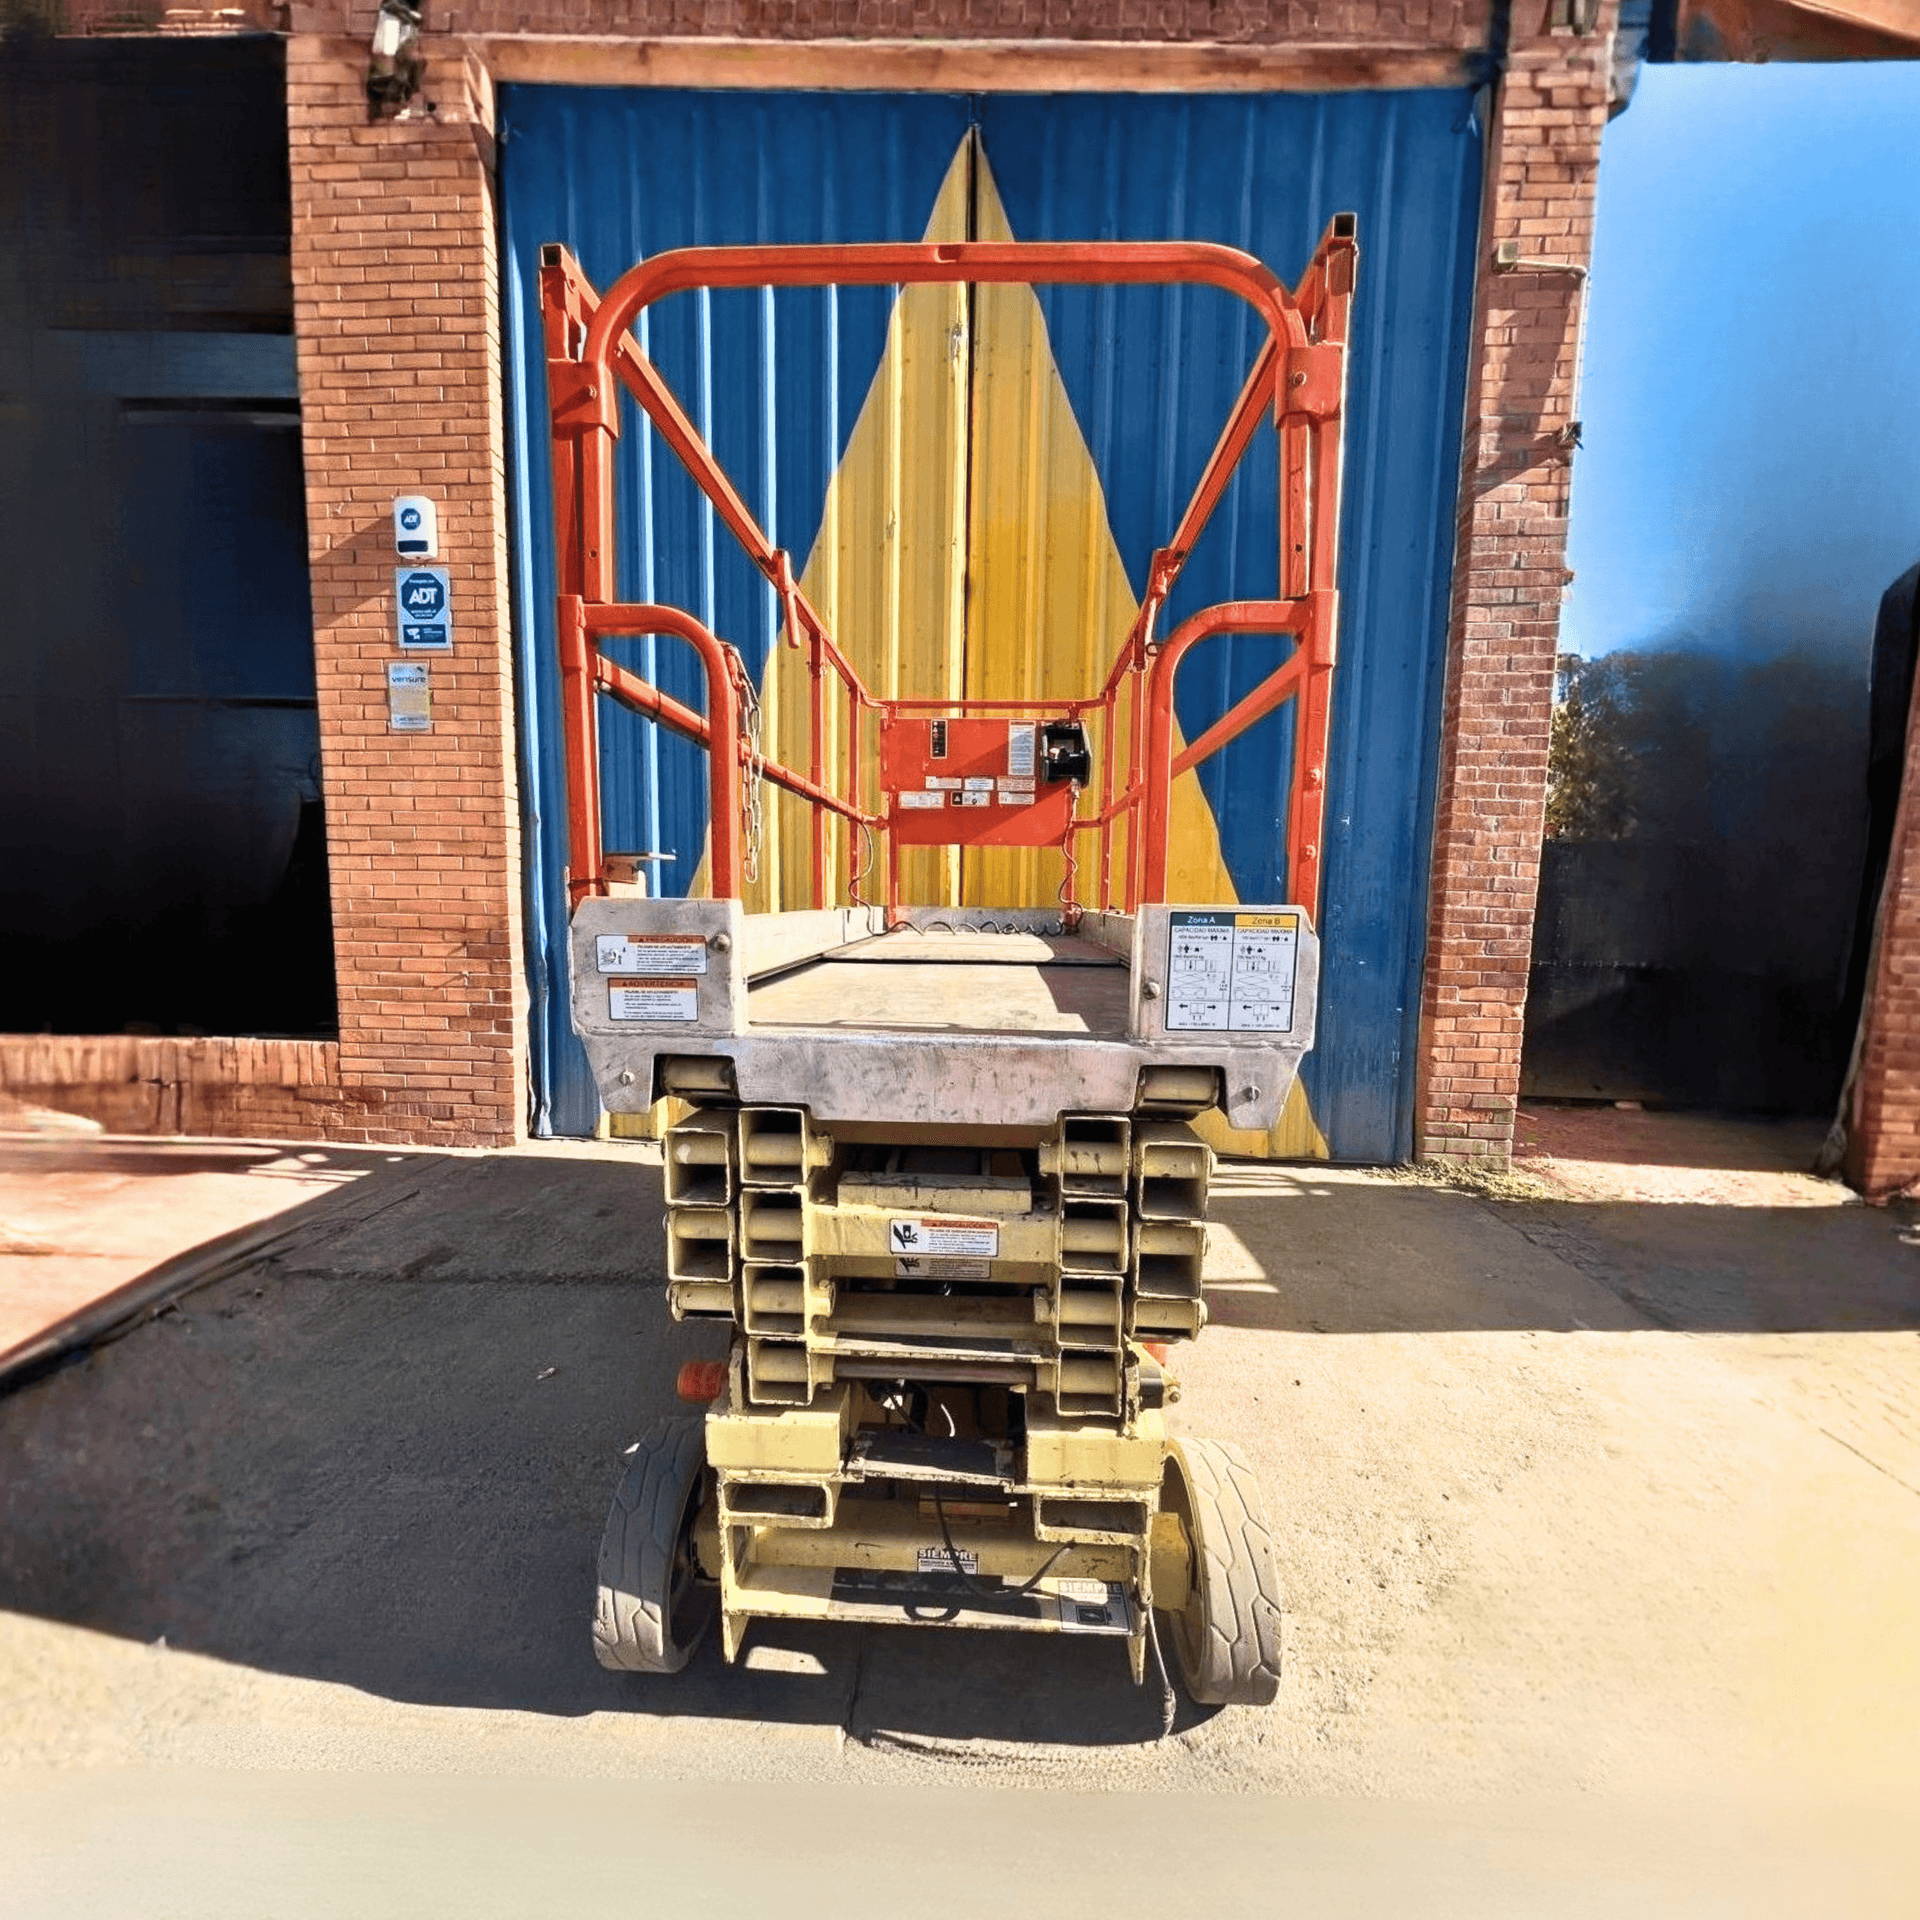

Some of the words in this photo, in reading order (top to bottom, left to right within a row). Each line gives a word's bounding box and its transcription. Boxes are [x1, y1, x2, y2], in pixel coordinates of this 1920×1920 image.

[409, 588, 438, 604] ADT
[1187, 916, 1207, 924] Zona
[1209, 916, 1216, 924] A
[1252, 917, 1273, 925] Zona
